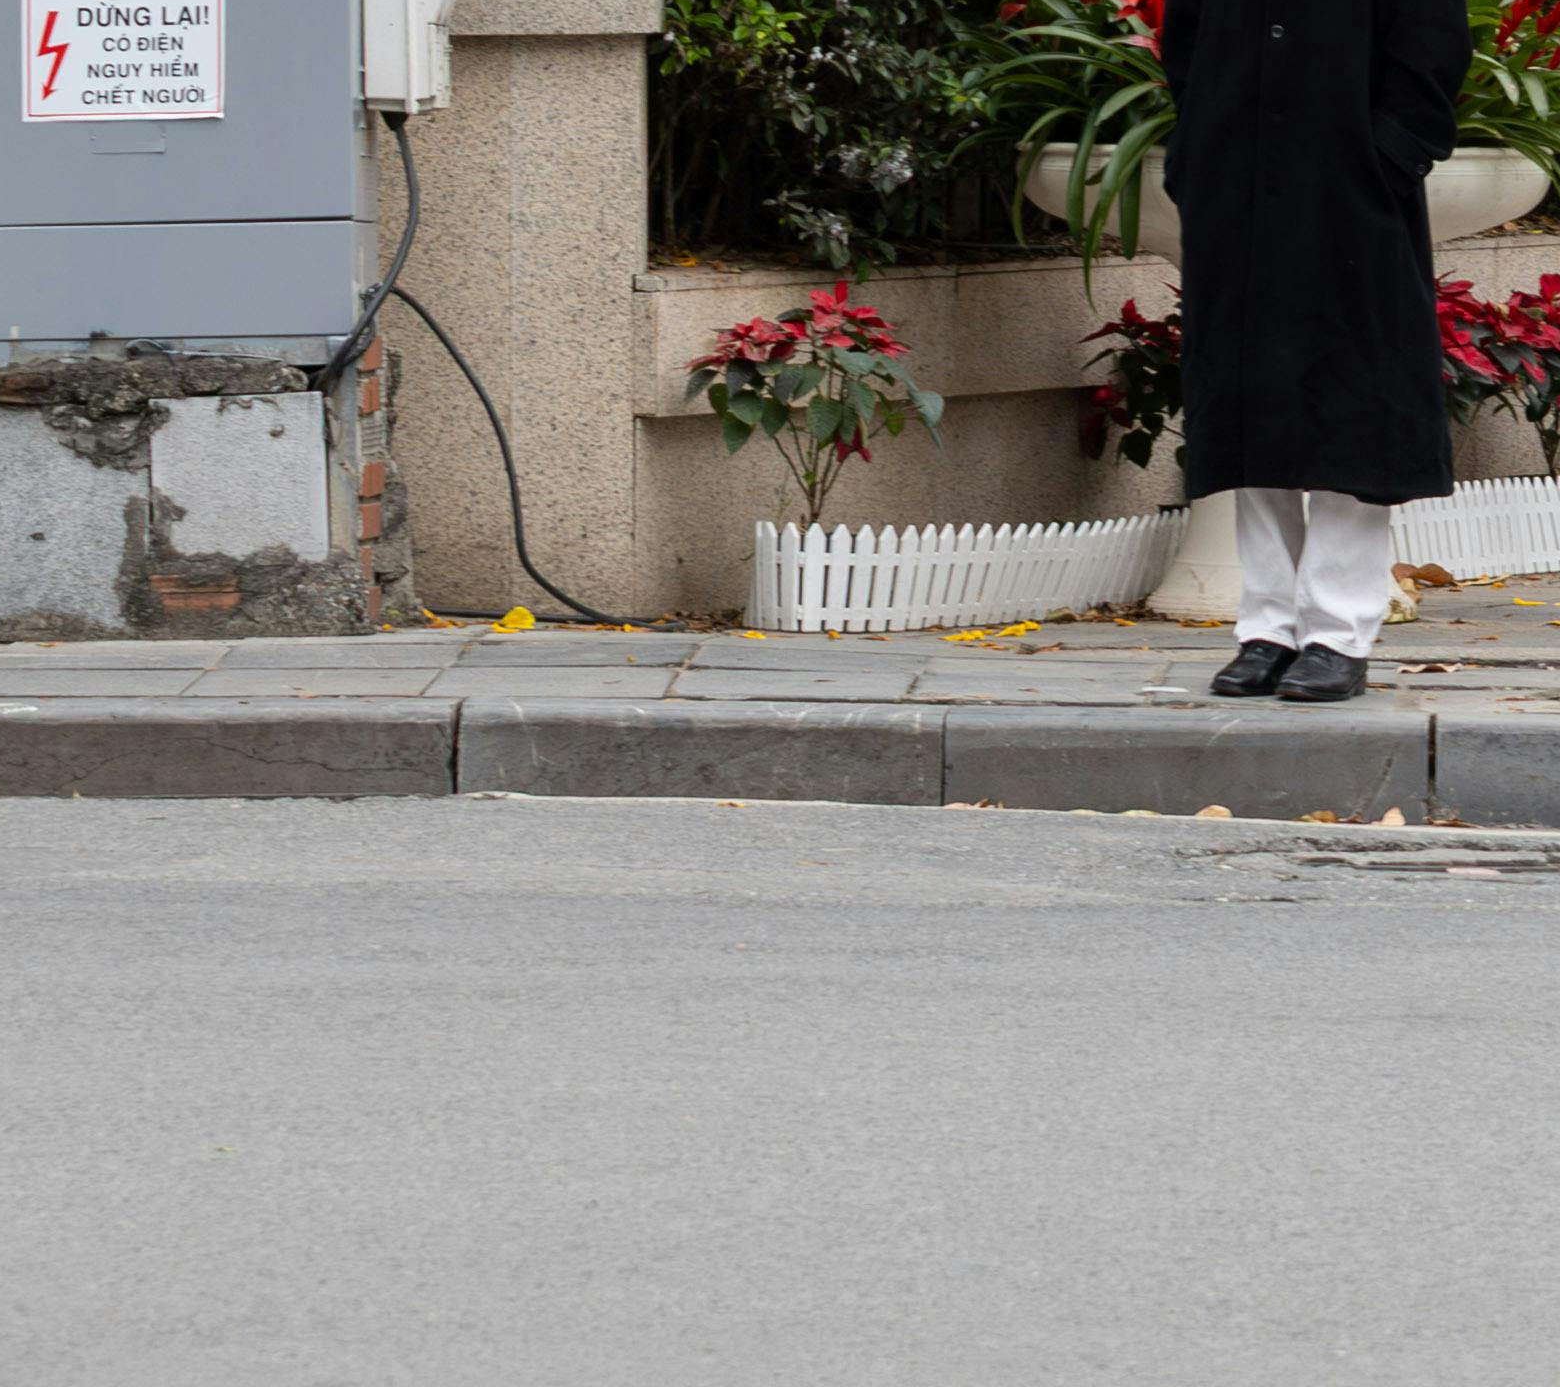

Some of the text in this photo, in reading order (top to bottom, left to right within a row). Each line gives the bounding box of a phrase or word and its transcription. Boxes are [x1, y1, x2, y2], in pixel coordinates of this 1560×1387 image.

[77, 2, 209, 30] DỪNG LẠI!
[102, 33, 184, 54] CÓ ĐIỆN
[87, 55, 199, 78] NGUY HIỂM
[81, 84, 205, 105] CHẾT NGƯỜI
